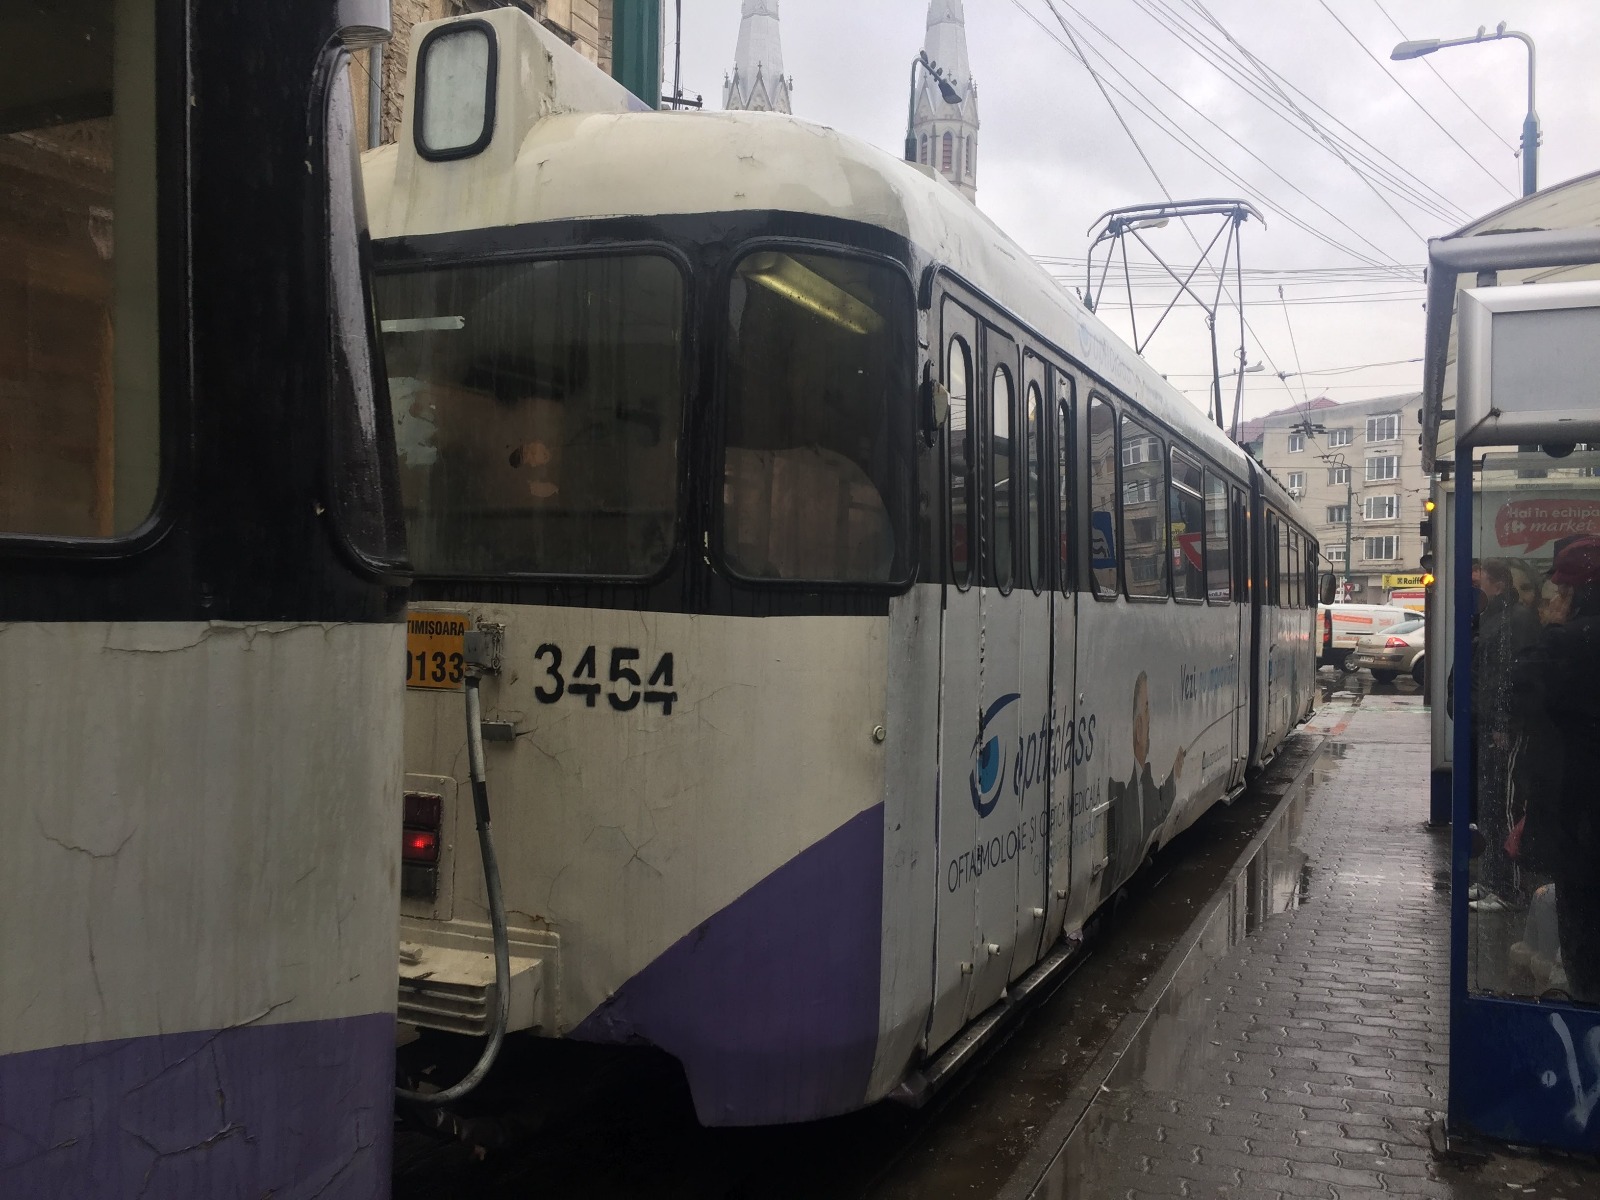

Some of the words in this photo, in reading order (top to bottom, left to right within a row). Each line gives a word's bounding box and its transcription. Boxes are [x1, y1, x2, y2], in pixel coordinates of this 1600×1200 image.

[1509, 507, 1532, 518] Hai
[1529, 519, 1595, 533] market
[534, 643, 678, 715] 3454
[1180, 663, 1197, 701] Vezi
